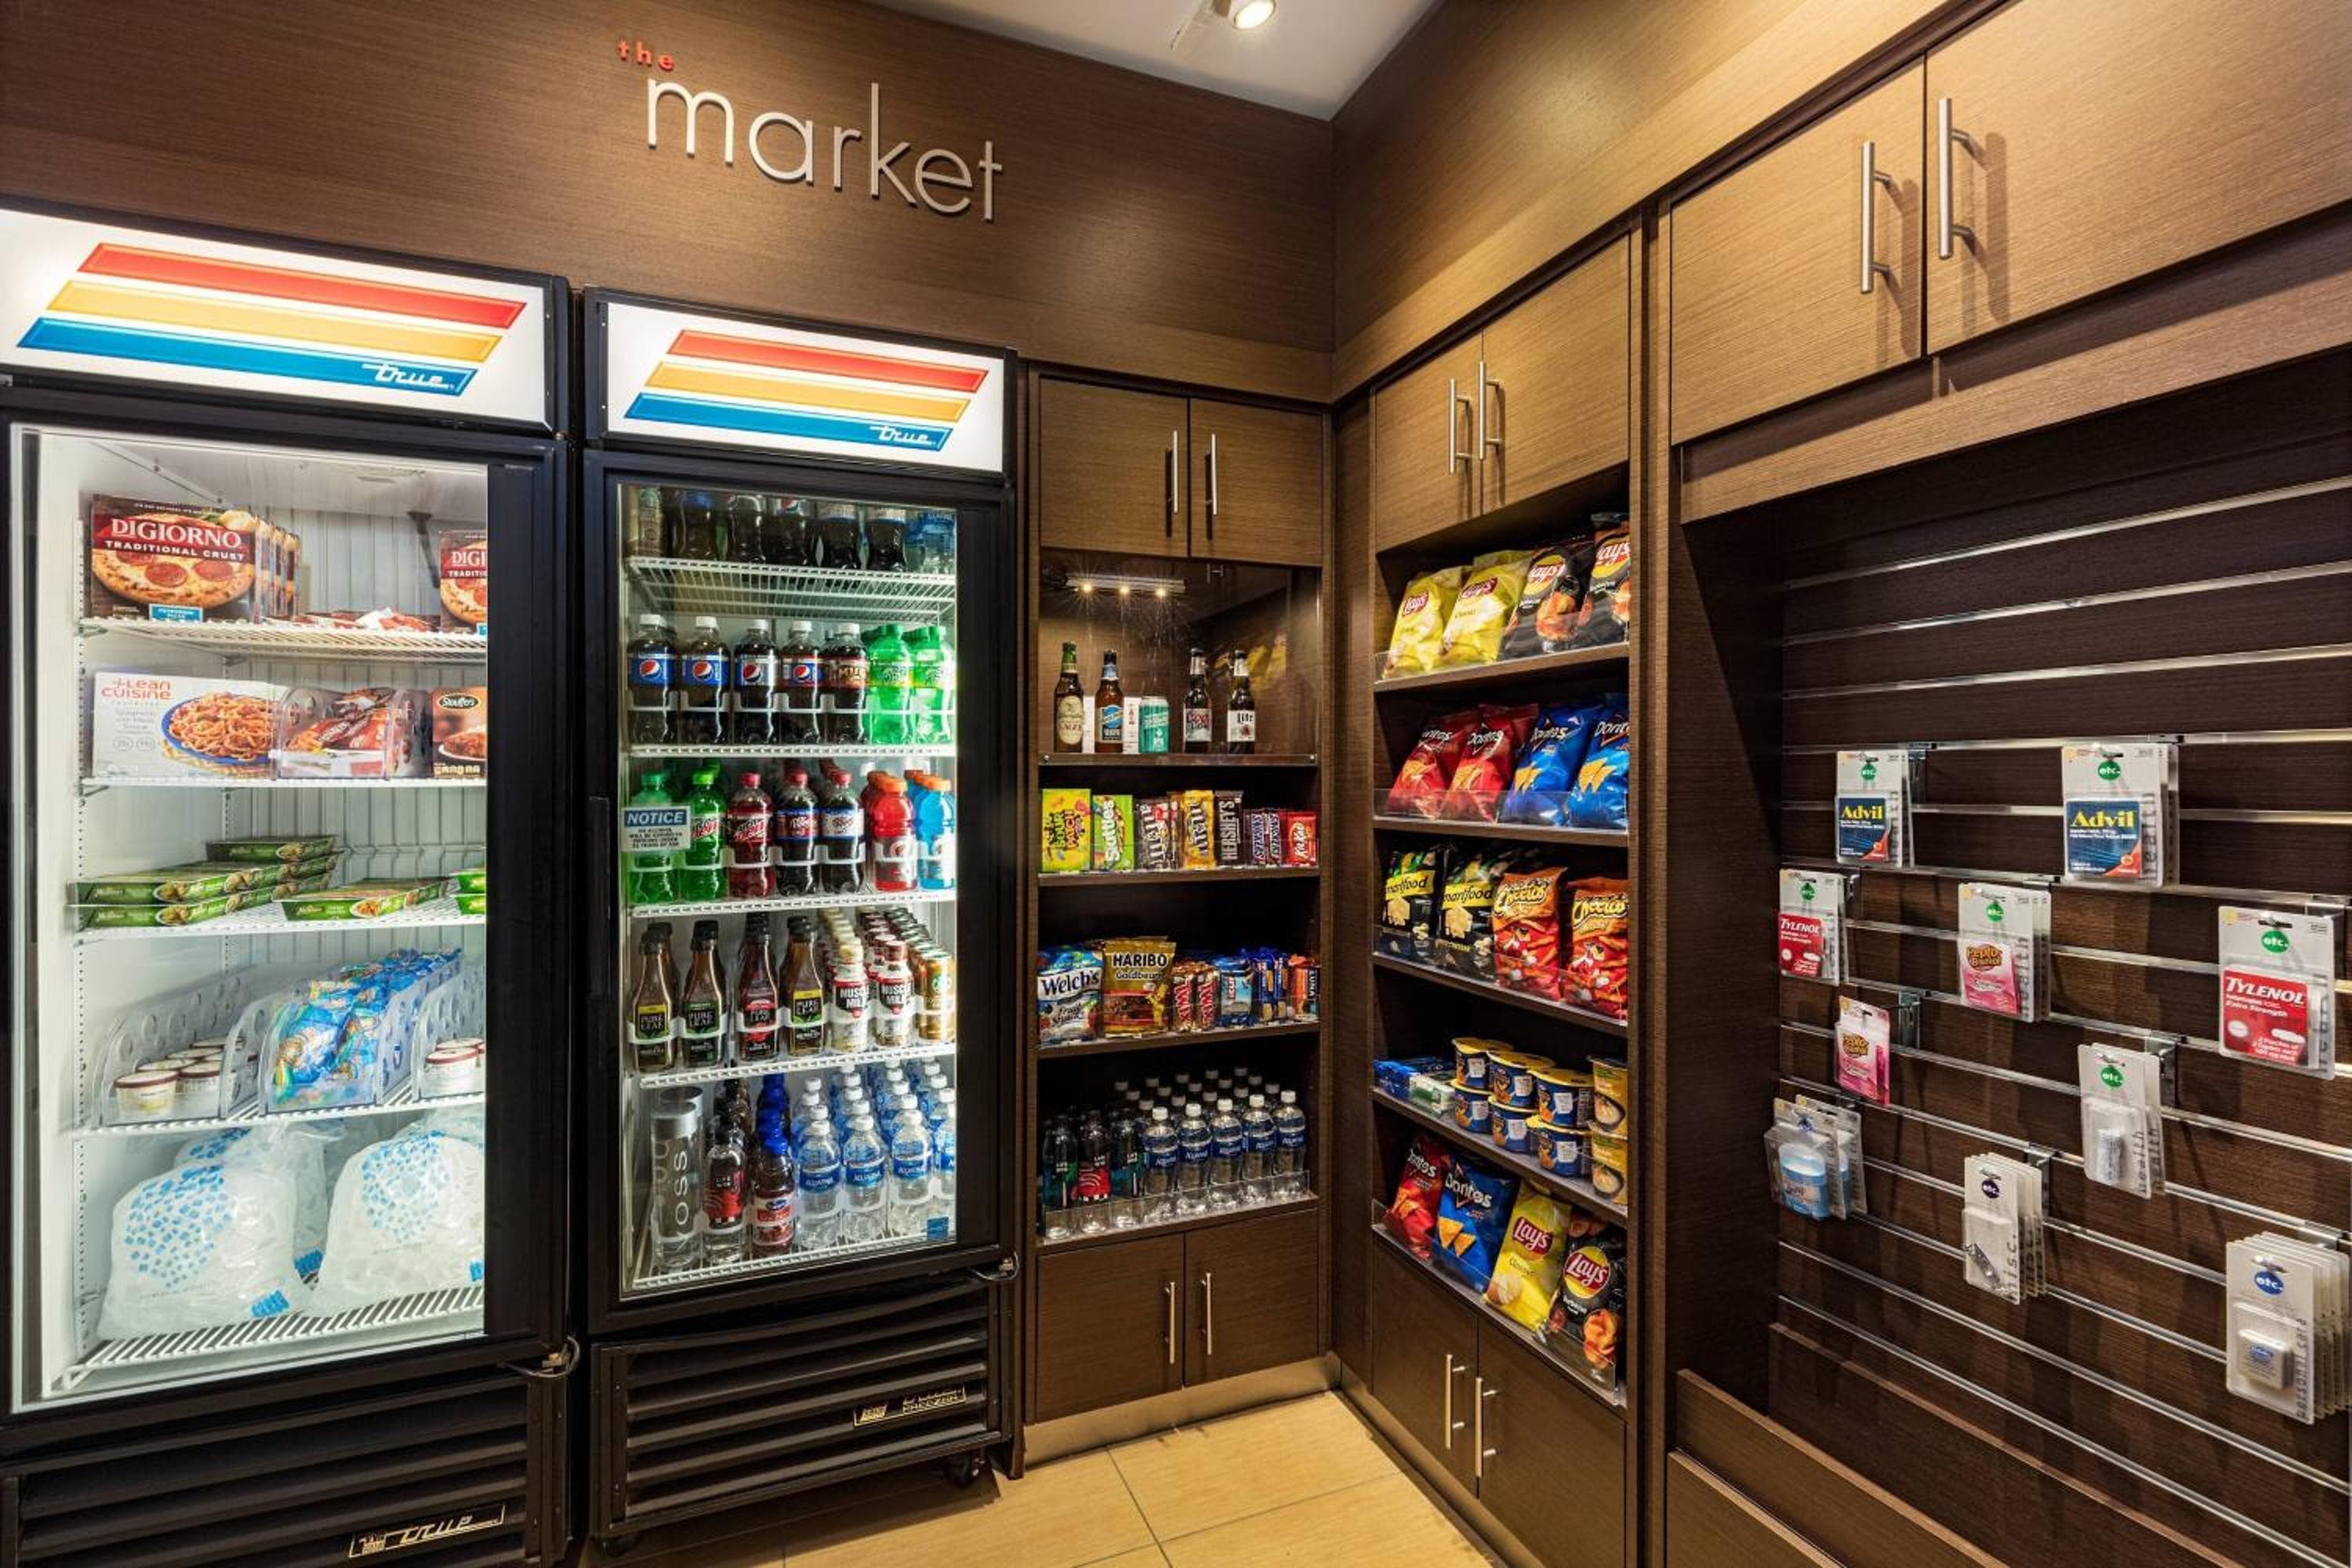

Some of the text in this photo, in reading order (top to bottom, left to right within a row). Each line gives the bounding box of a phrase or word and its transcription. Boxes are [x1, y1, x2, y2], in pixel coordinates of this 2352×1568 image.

[617, 38, 675, 71] the
[647, 78, 1004, 222] market
[105, 539, 245, 561] TRADITIONAL CRUST
[626, 811, 684, 825] NOTICE
[1842, 805, 1883, 820] Advil
[2069, 810, 2134, 828] Advil
[2263, 937, 2288, 947] etc.
[1112, 953, 1168, 967] HARIBO
[1040, 970, 1100, 996] Welch's
[2225, 976, 2307, 1005] TYLENOL
[1445, 1172, 1493, 1208] Doritos
[2256, 1276, 2284, 1292] etc.
